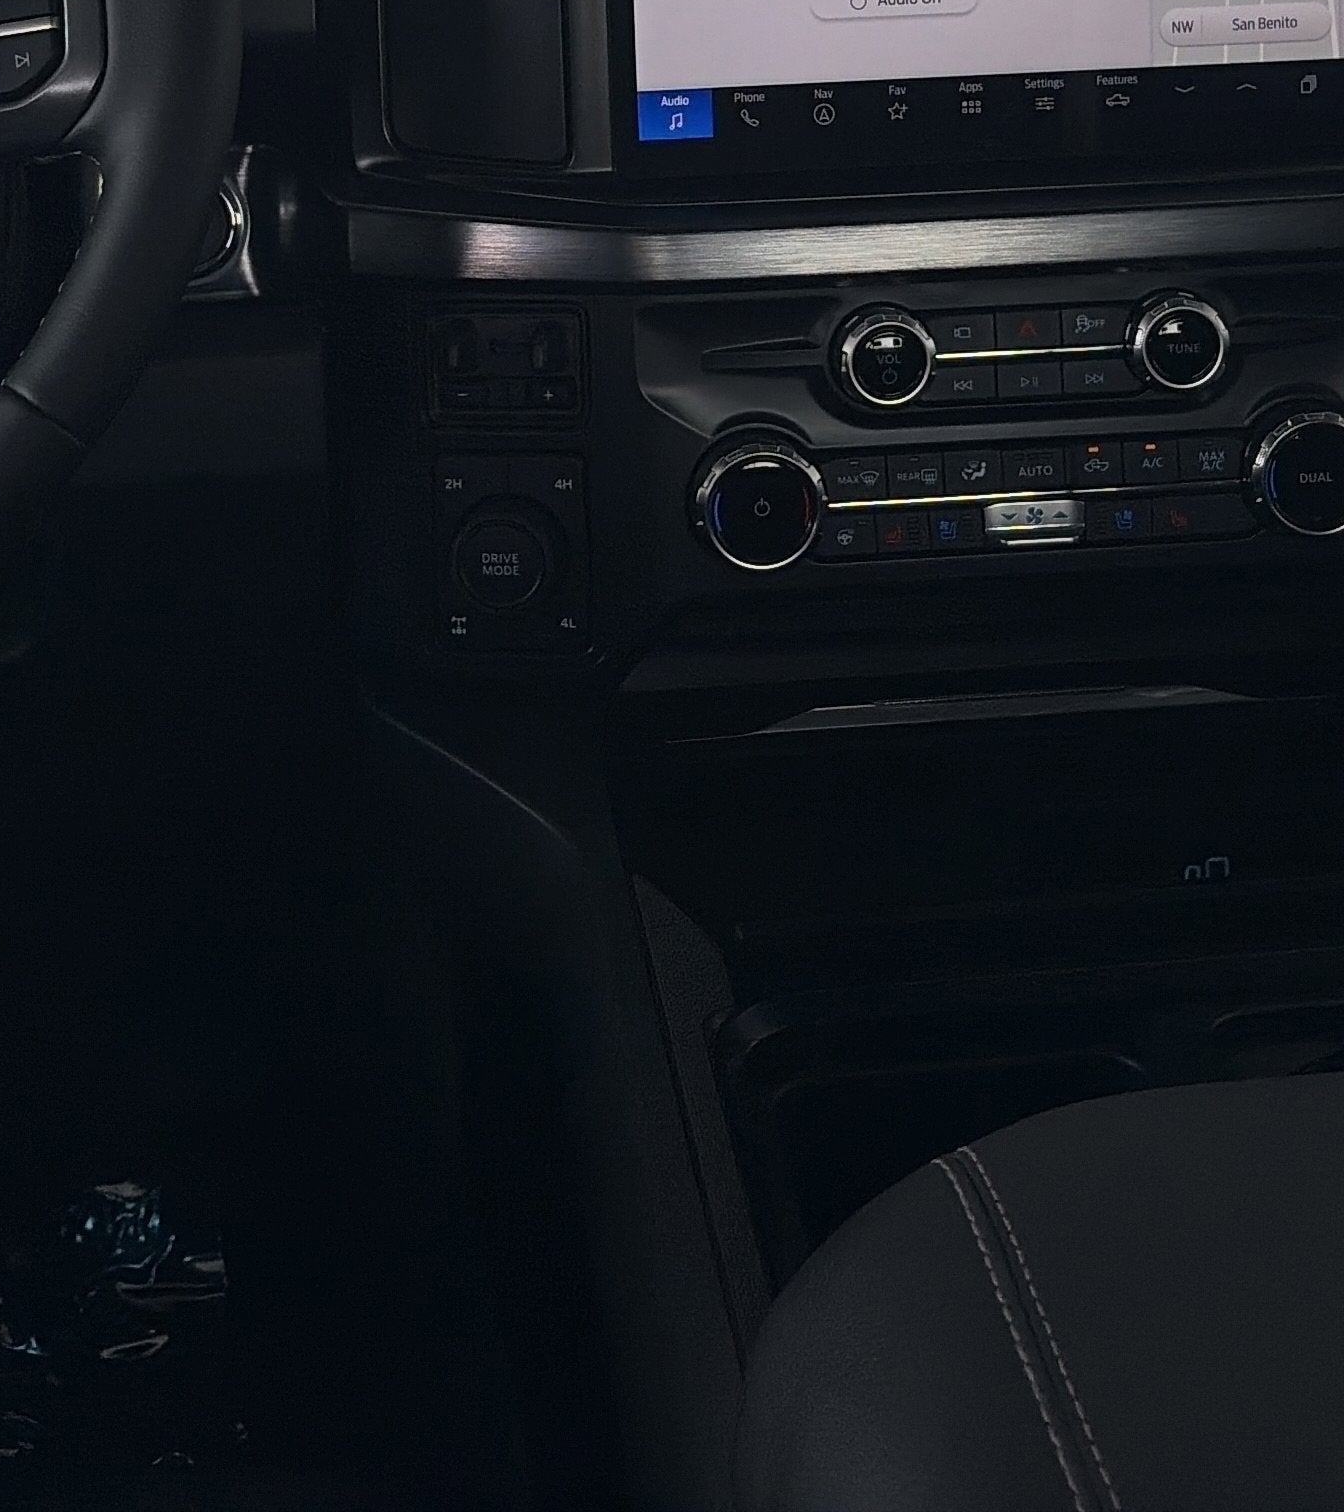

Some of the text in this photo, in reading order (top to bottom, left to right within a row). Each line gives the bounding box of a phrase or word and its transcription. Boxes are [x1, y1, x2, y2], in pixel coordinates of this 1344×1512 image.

[1171, 20, 1194, 34] NW
[1232, 15, 1298, 32] San Benito
[1024, 77, 1065, 91] Settings
[1096, 74, 1138, 87] Features
[888, 84, 907, 96] Fav
[959, 81, 984, 94] Apps
[733, 91, 766, 104] Phone
[814, 88, 834, 100] Nav
[660, 95, 690, 107] Audio
[1088, 318, 1106, 328] OFF
[1167, 343, 1201, 354] TUNE
[877, 354, 902, 365] VOL
[1199, 450, 1225, 462] MAX
[1142, 456, 1164, 469] A/C
[1201, 461, 1224, 472] A/C
[897, 471, 920, 481] REAR
[1019, 464, 1053, 478] AUTO
[1300, 471, 1333, 483] DUAL
[445, 478, 463, 489] 2H
[554, 478, 573, 490] 4H
[837, 474, 860, 485] MAX
[481, 552, 520, 564] DRIVE
[482, 565, 520, 577] MODE
[560, 617, 577, 629] 4L
